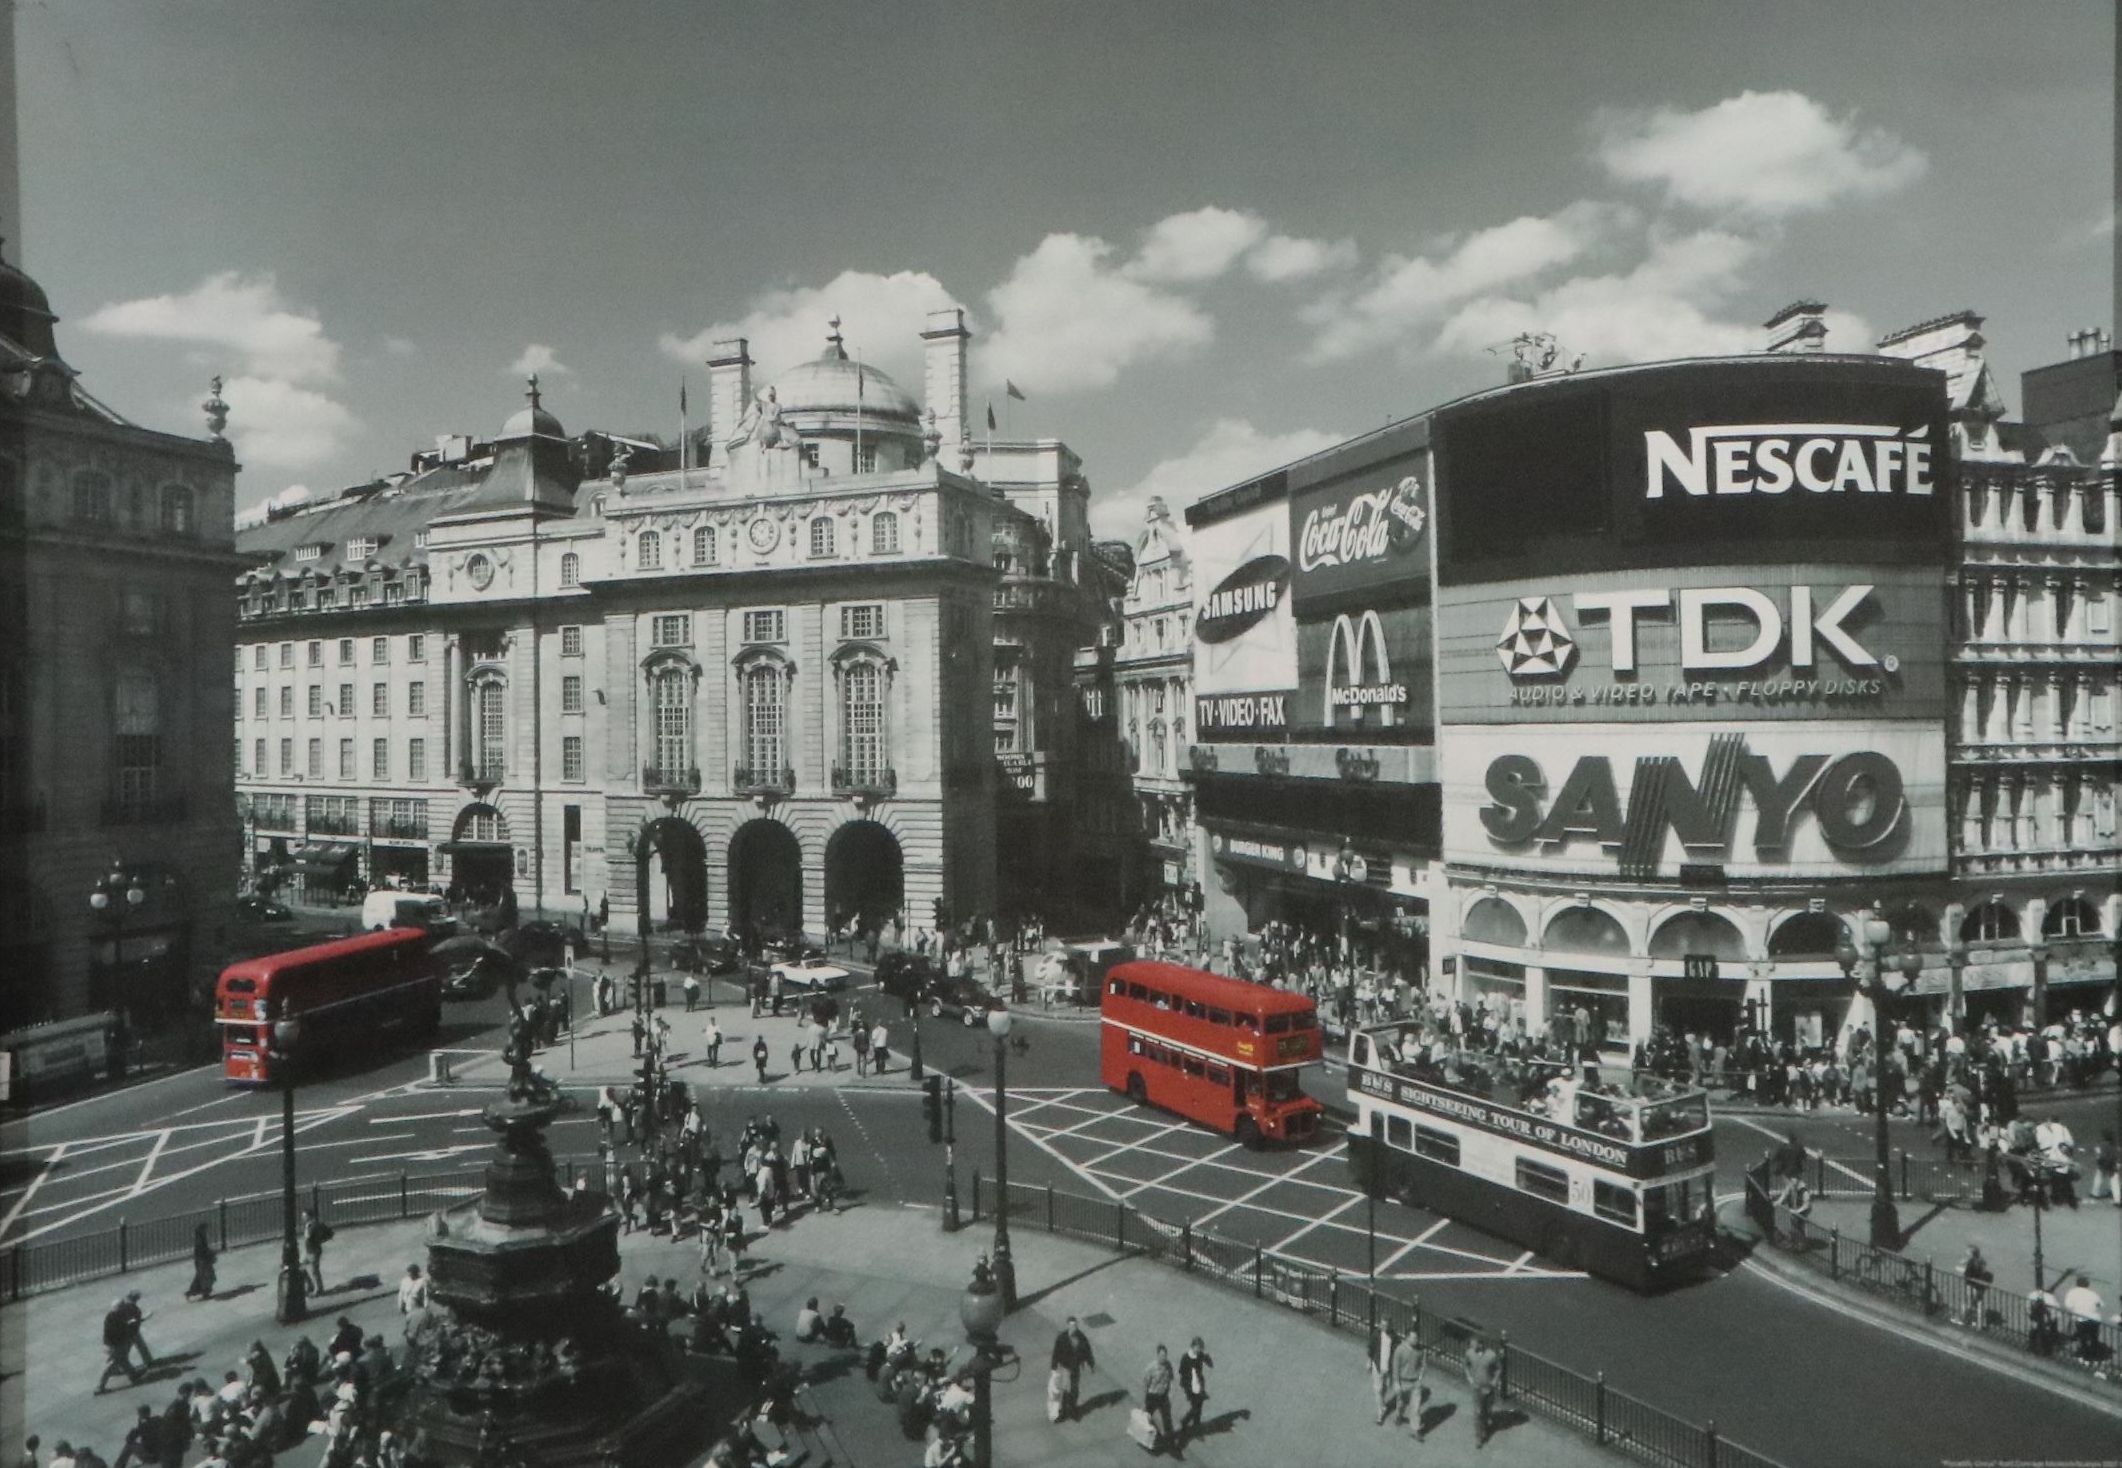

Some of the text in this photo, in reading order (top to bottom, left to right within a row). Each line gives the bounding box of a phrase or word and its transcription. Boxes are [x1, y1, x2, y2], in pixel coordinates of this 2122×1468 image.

[1644, 424, 1934, 498] NESCAFÉ
[1299, 487, 1393, 573] Coca-Cola
[1202, 581, 1276, 619] SAMSUNG
[1573, 585, 1880, 671] TDK
[1331, 683, 1407, 705] McDonald's
[1508, 678, 1881, 700] AUDIO & VIDEO TAPE FLOPPY DISKS
[1479, 732, 1903, 876] SANYO
[1261, 844, 1285, 862] KING
[1400, 1085, 1487, 1121] SIGHTSEEING
[1490, 1111, 1532, 1135] TOUR
[1534, 1125, 1557, 1141] OF
[1559, 1131, 1629, 1164] LONDON
